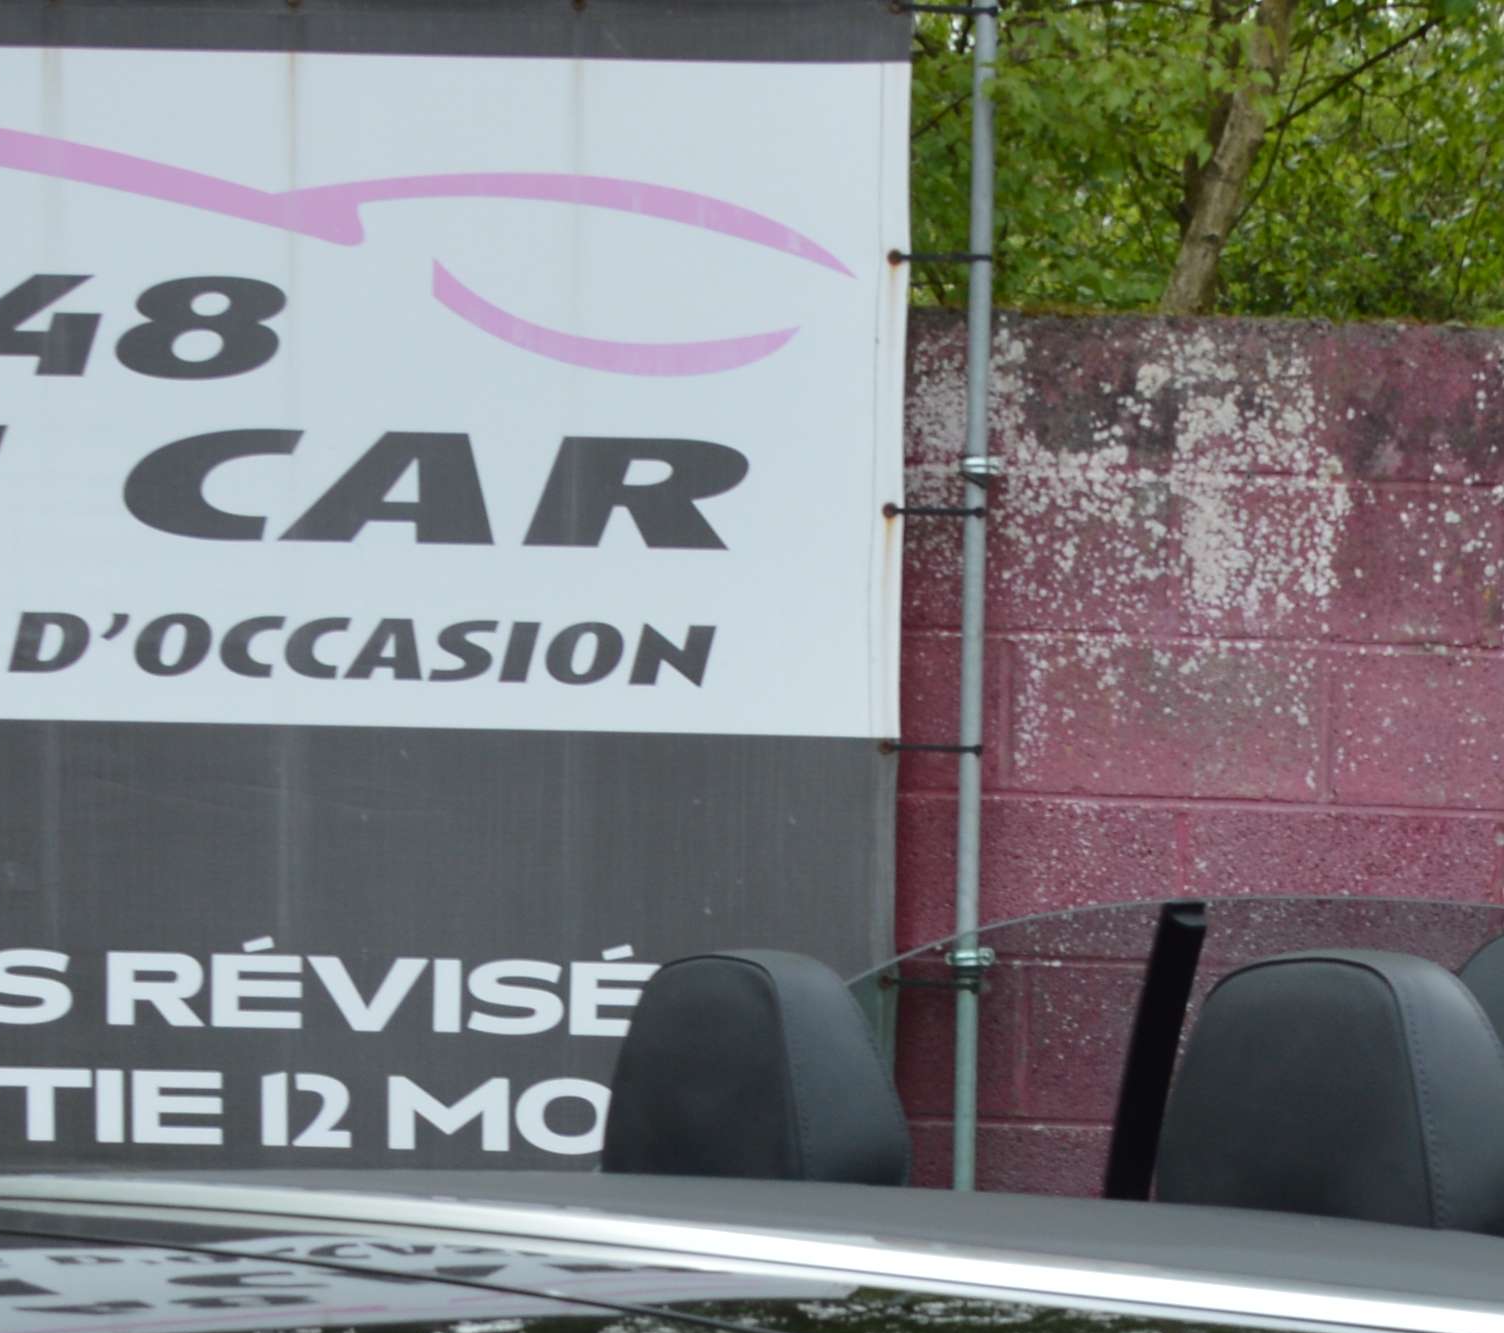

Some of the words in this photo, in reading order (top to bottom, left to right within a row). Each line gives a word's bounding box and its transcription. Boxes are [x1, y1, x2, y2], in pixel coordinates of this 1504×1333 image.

[123, 428, 749, 550] CAR
[8, 611, 716, 687] D'OCCASION
[261, 1071, 352, 1149] 12
